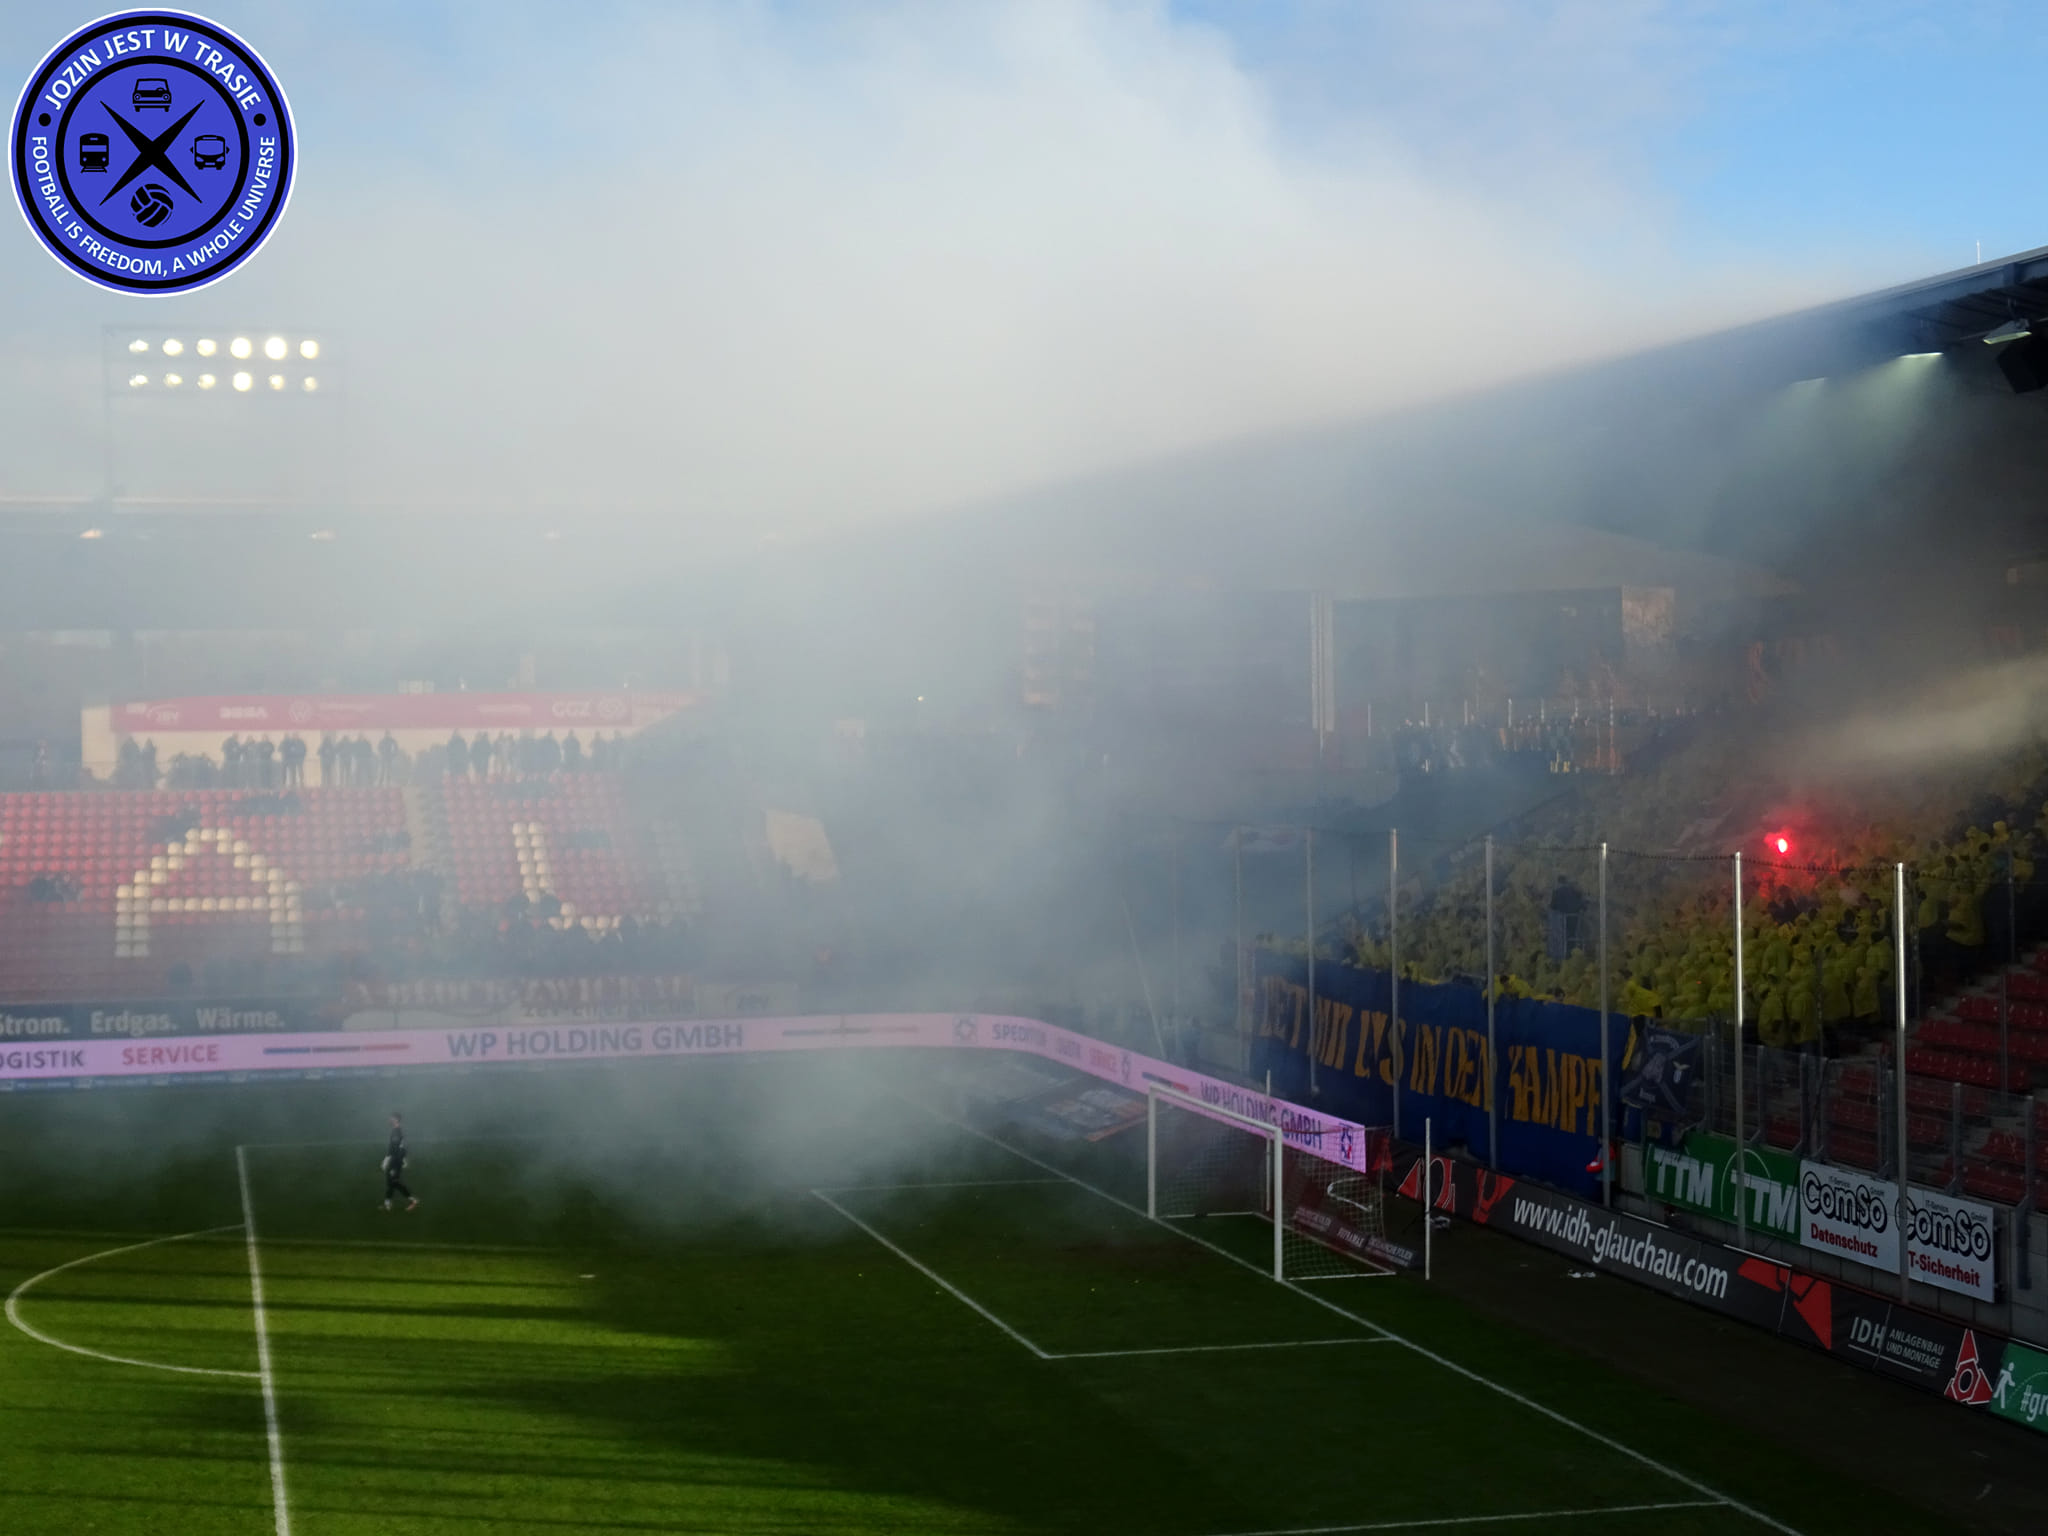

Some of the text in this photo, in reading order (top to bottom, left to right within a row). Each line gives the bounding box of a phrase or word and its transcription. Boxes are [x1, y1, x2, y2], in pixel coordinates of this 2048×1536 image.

[90, 1009, 177, 1037] Erdgas.
[195, 1007, 285, 1031] Wärme.
[446, 1023, 744, 1057] WP HOLDING GMBH
[0, 1043, 220, 1070] GISTIK SERVICE
[1280, 1108, 1323, 1150] GMBH
[1652, 1146, 1714, 1209] TTM
[1730, 1168, 1798, 1235] TTM
[1802, 1170, 1888, 1234] ComSo
[1513, 1197, 1728, 1299] www.idh-glauchau.com
[1810, 1223, 1878, 1259] Datenschutz
[1849, 1316, 1945, 1357] IDH ANLAGENBAU
[1886, 1341, 1942, 1369] UND MONTAGE
[2019, 1384, 2048, 1423] #gr
